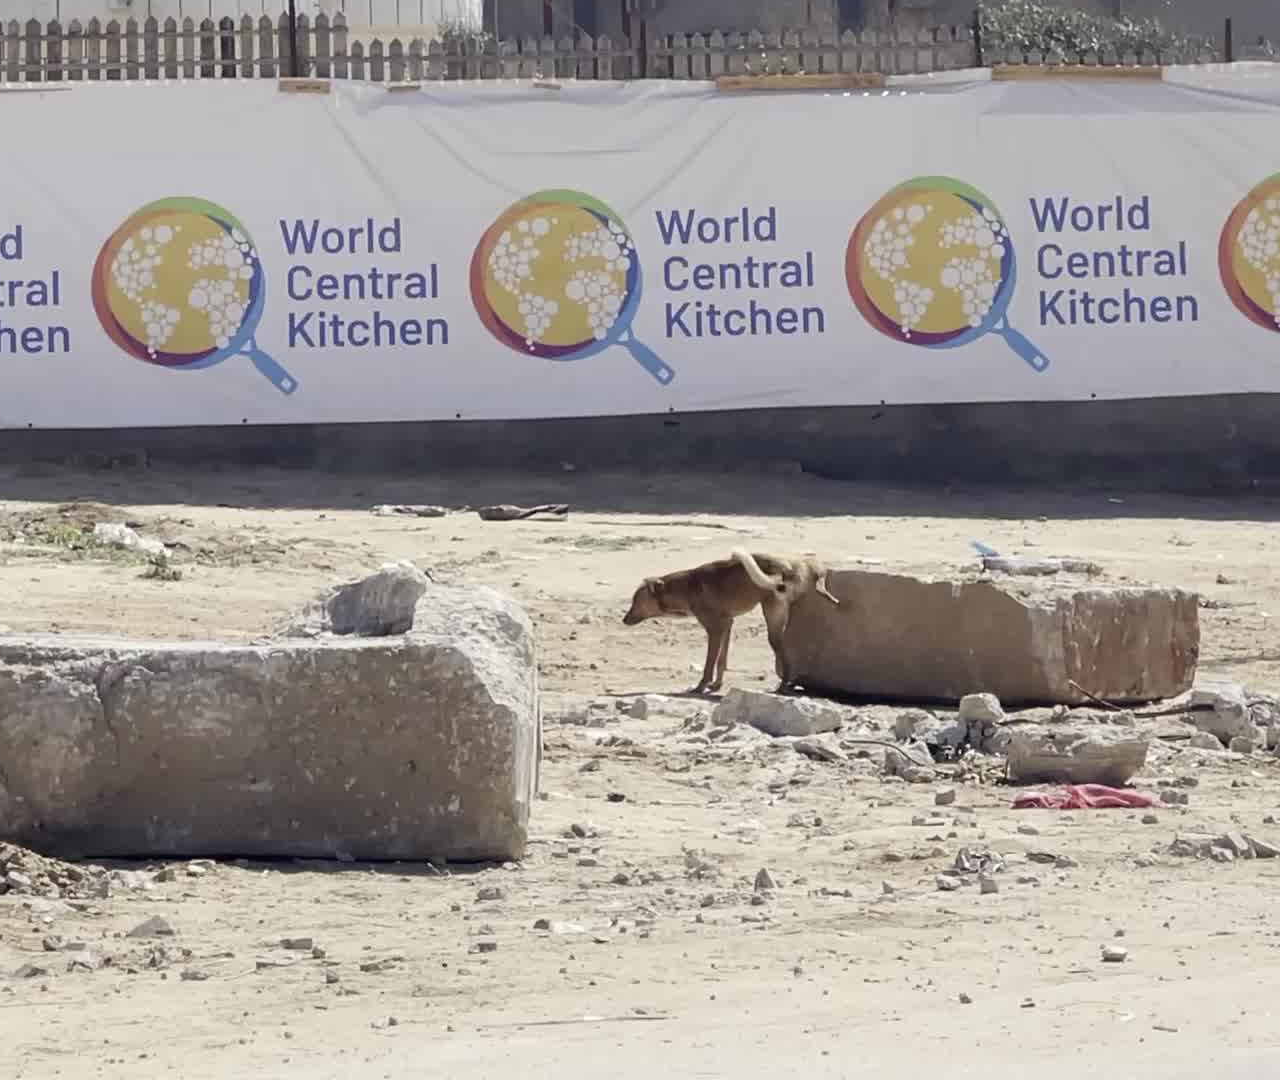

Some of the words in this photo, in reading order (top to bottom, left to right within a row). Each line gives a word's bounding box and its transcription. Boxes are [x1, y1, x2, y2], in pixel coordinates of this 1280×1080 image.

[655, 206, 777, 246] World
[1029, 195, 1150, 233] World
[279, 218, 401, 255] World
[663, 251, 814, 292] Central
[1037, 241, 1187, 280] Central
[287, 263, 438, 301] Central
[665, 299, 825, 338] Kitchen
[1039, 287, 1199, 326] Kitchen
[288, 311, 449, 348] Kitchen
